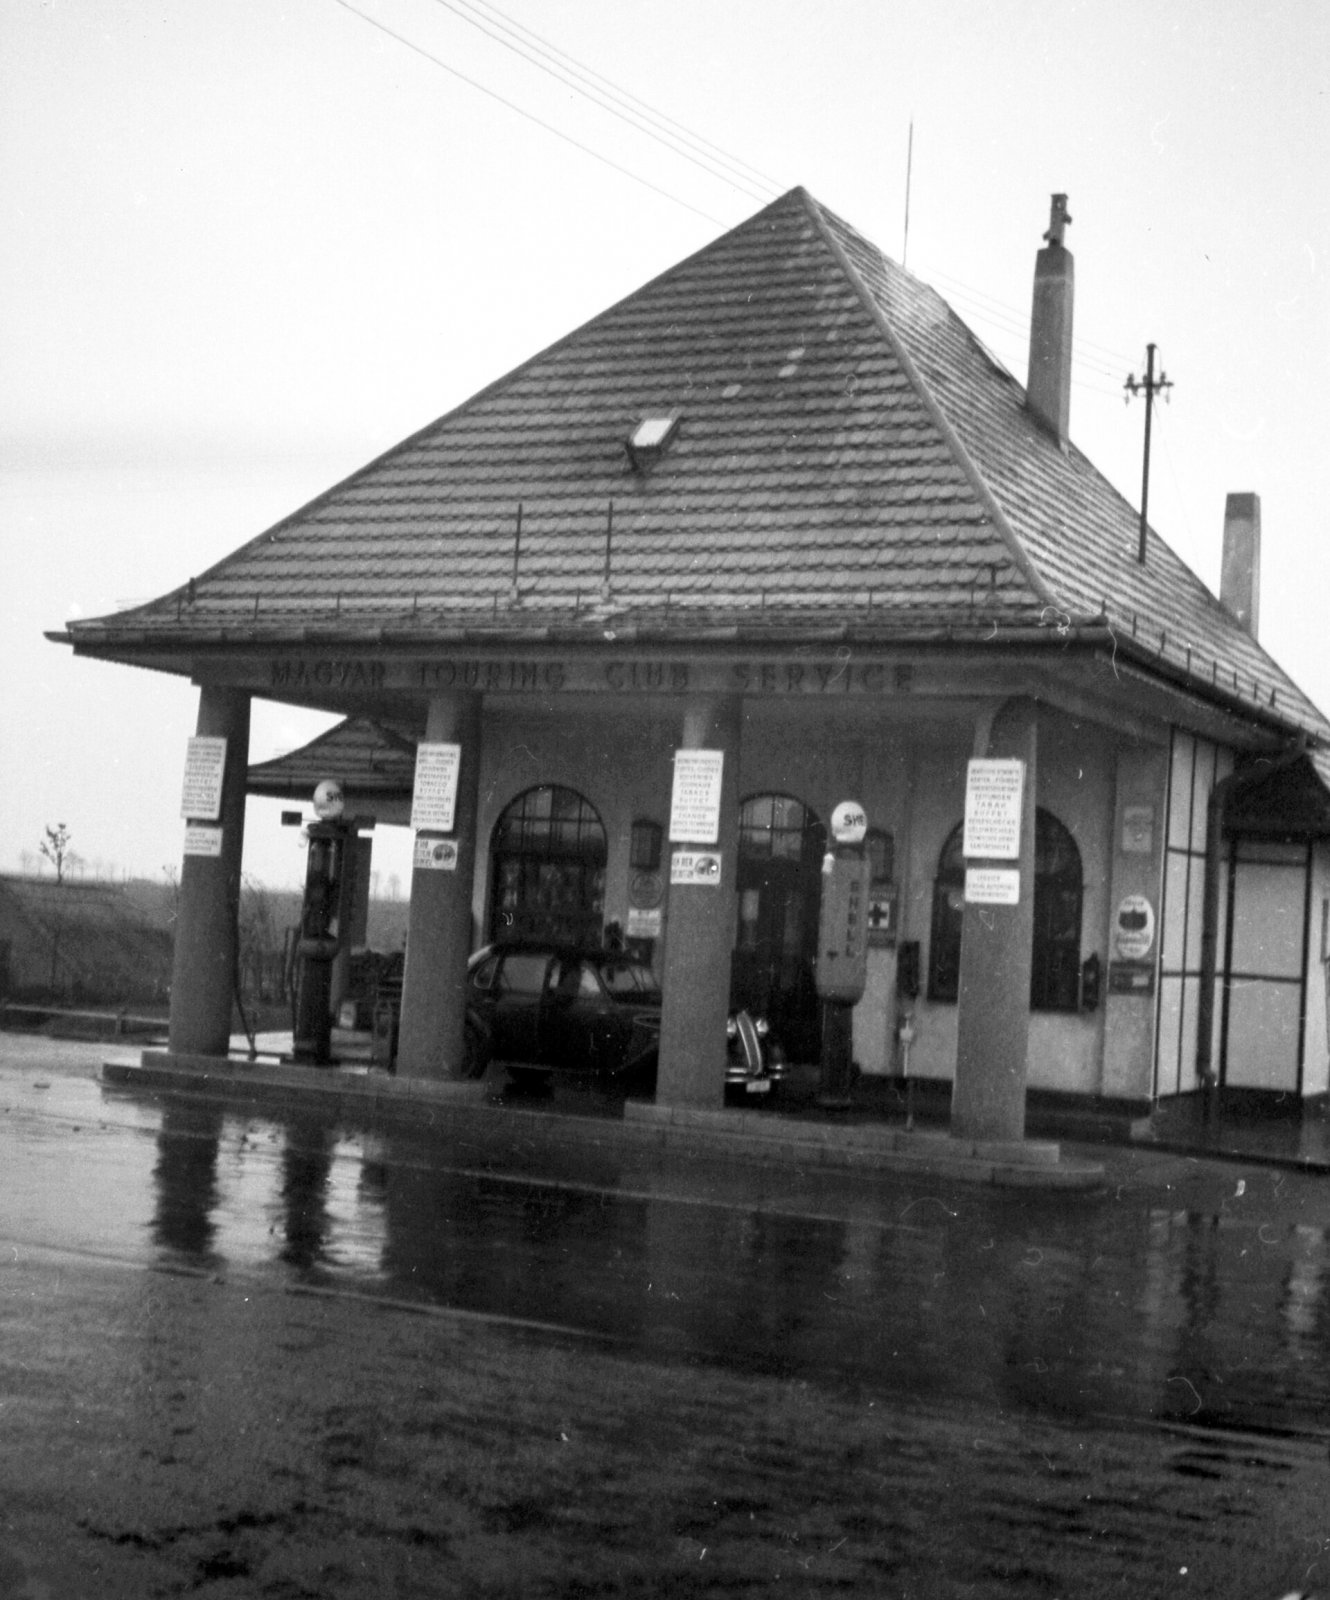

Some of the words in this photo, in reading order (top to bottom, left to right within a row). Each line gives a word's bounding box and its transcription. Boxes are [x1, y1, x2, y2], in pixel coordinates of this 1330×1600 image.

[271, 660, 387, 687] MAGYAR
[416, 660, 566, 689] TOURING
[603, 661, 690, 689] CLUB
[731, 663, 914, 692] SERVICE
